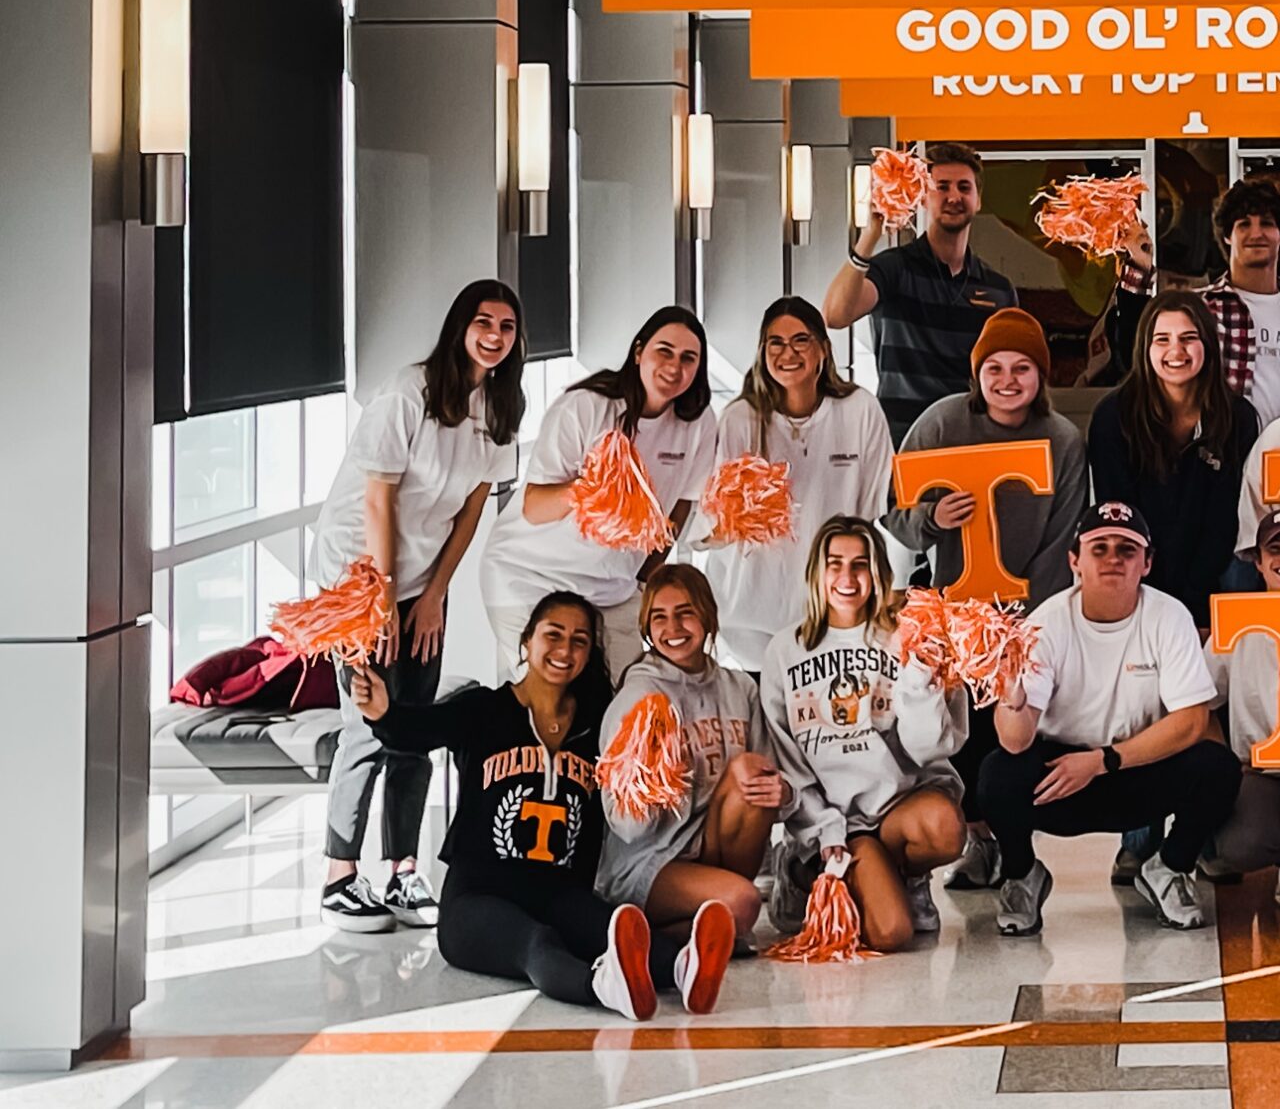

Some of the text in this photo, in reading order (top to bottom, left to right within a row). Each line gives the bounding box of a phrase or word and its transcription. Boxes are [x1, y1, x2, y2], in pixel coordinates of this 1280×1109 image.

[896, 8, 1070, 52] GOOD
[933, 74, 1083, 96] ROCKY
[892, 438, 1055, 603] T
[787, 647, 901, 692] TENNESSEE
[841, 741, 870, 754] 2021
[519, 800, 568, 863] T
